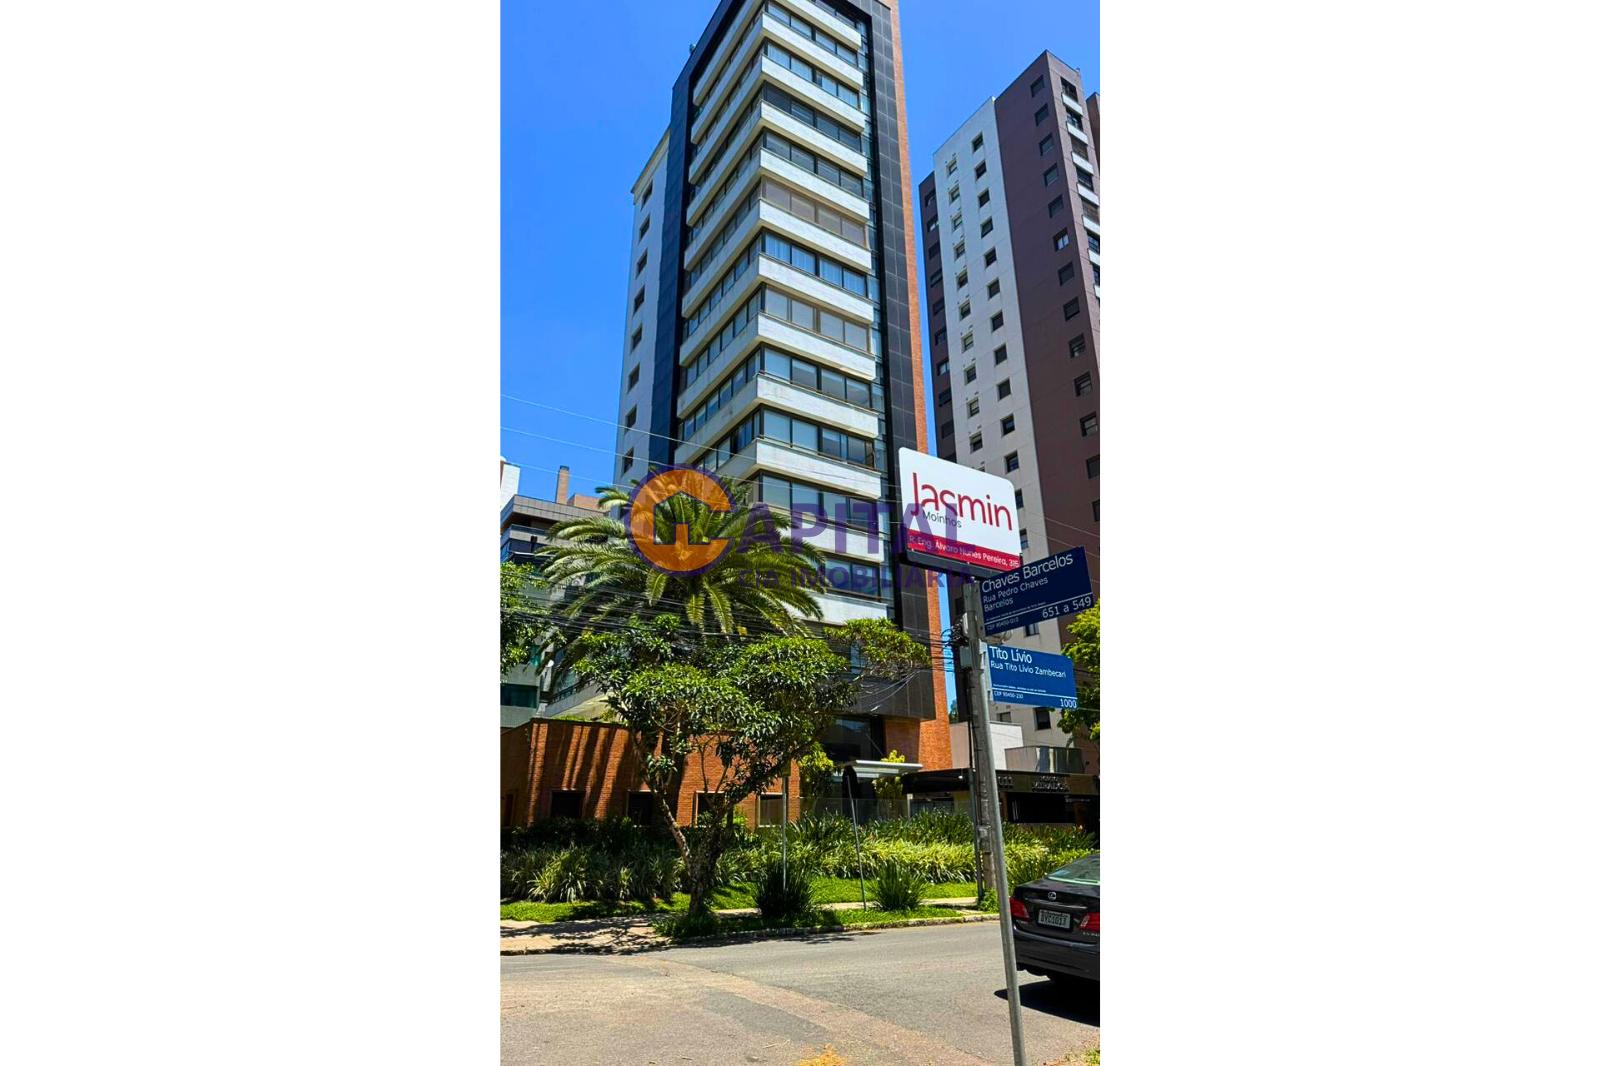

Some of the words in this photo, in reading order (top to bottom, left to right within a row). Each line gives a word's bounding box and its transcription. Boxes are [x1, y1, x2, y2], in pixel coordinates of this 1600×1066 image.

[911, 472, 1013, 531] Jasmin
[923, 511, 962, 529] Moinhos
[917, 536, 933, 550] Eng.
[959, 546, 982, 560] Nunes
[981, 570, 1020, 593] Chaves
[1023, 553, 1074, 580] Barcelos
[983, 591, 996, 603] Rua
[998, 586, 1018, 599] Pedro
[1020, 576, 1049, 591] Chaves
[983, 598, 1014, 613] Barcelos
[1041, 604, 1060, 619] 651
[1063, 603, 1070, 613] a
[1072, 596, 1092, 611] 549
[989, 645, 1008, 660] Tito
[1010, 647, 1033, 663] Lívio
[990, 661, 1004, 670] Rua
[1004, 662, 1017, 671] Tito
[1018, 663, 1034, 674] Lívio
[1034, 666, 1066, 678] Zambecari
[1060, 698, 1077, 709] 1000
